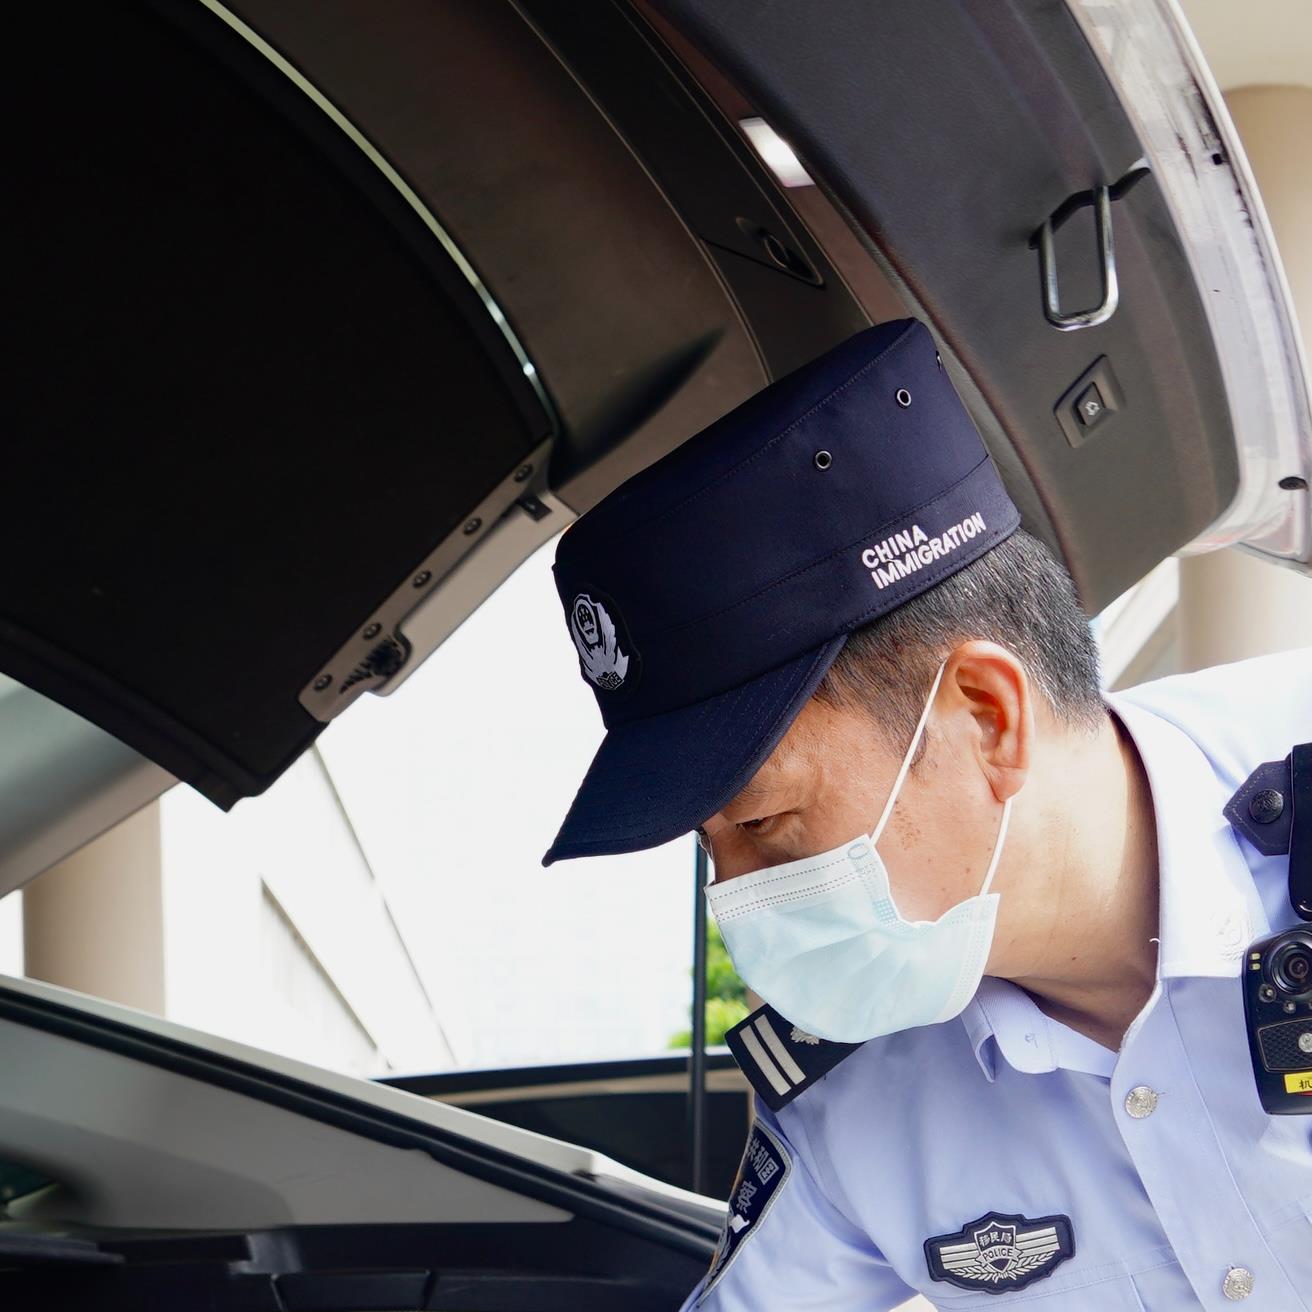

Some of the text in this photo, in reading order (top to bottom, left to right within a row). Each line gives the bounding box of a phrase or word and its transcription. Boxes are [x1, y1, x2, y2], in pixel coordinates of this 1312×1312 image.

[862, 525, 928, 568] CHINA
[871, 512, 987, 589] IMMIGRATION
[979, 1231, 1013, 1247] 移民局
[982, 1248, 1013, 1260] POLICE
